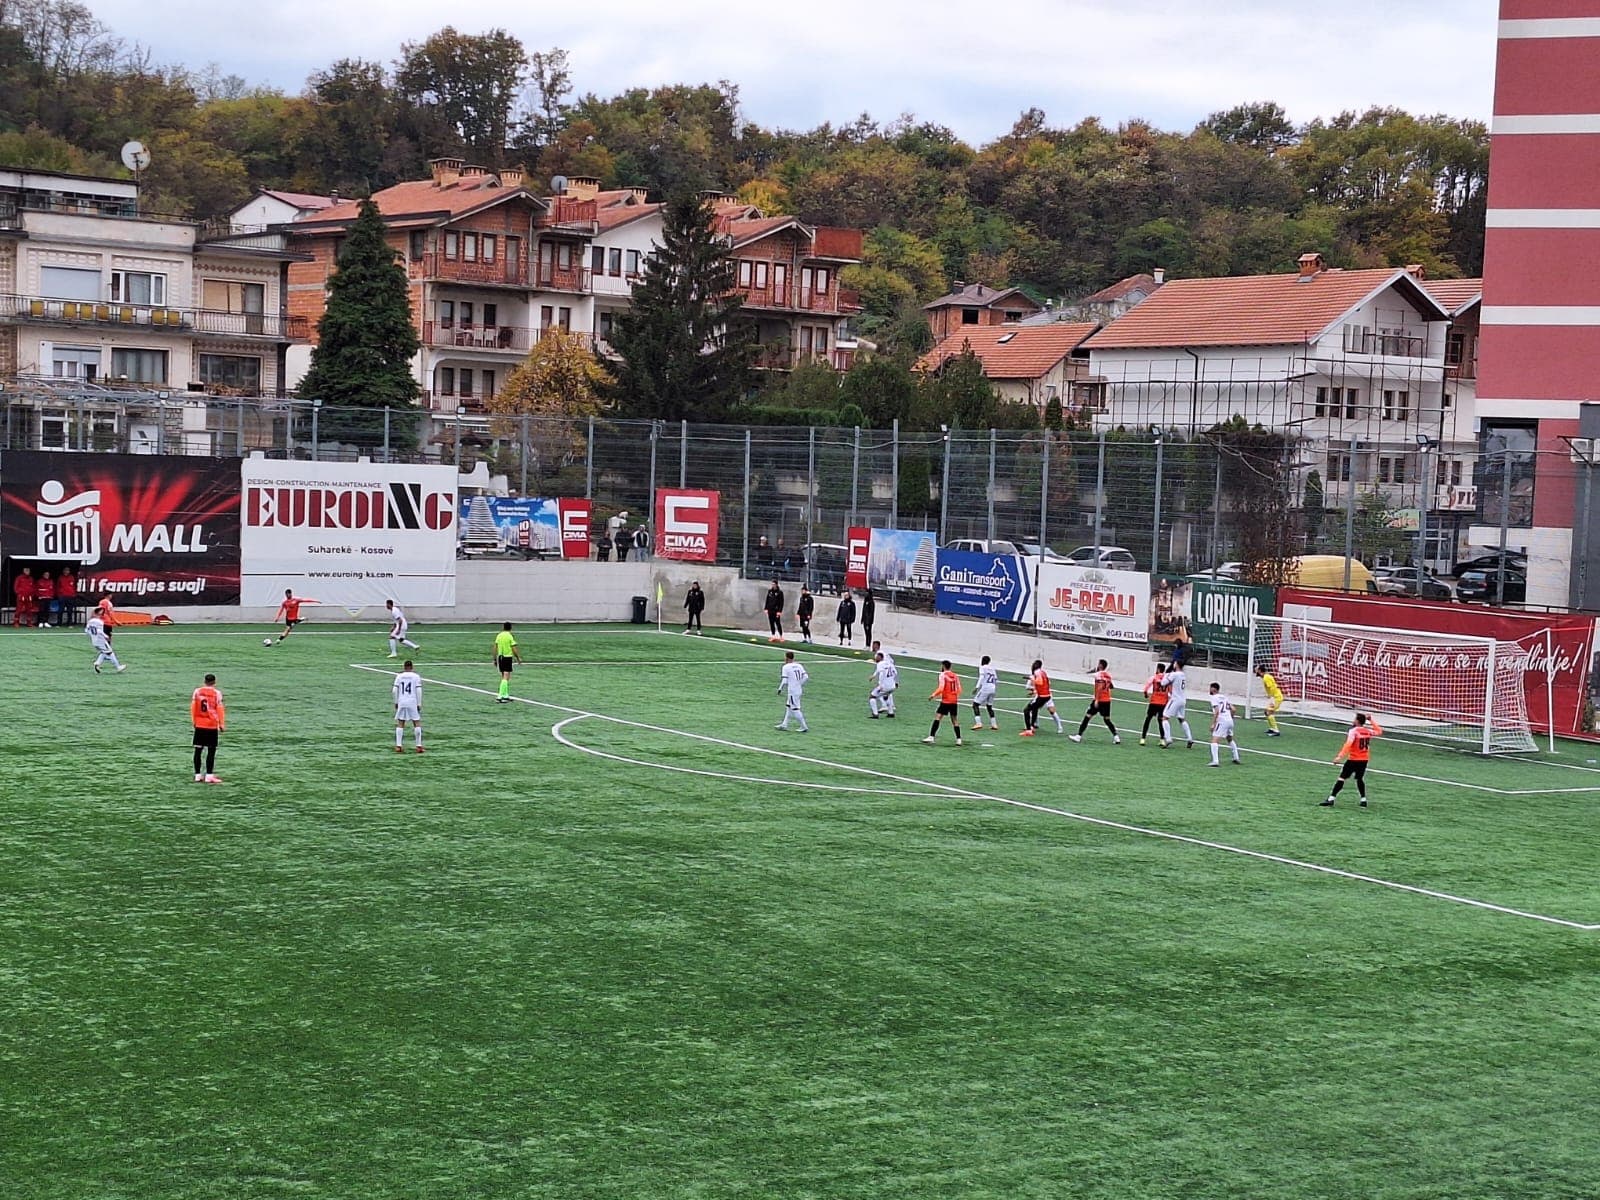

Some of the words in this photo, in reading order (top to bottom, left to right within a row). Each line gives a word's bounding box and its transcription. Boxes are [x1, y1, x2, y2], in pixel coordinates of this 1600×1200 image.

[247, 482, 453, 530] EUROING
[43, 507, 95, 555] albi
[108, 523, 208, 552] MALL
[664, 534, 707, 548] CIMA
[307, 545, 352, 554] Suharekë
[360, 545, 394, 555] Kosovë
[940, 565, 967, 582] Gani
[967, 571, 1006, 587] Transport
[98, 578, 165, 596] familjes
[167, 578, 207, 595] suaj!
[1049, 587, 1135, 616] JE-REALI
[1197, 592, 1259, 628] LORIANO
[1278, 657, 1328, 678] CIMA
[1454, 653, 1471, 669] se
[401, 681, 411, 695] 14
[201, 699, 207, 713] 6
